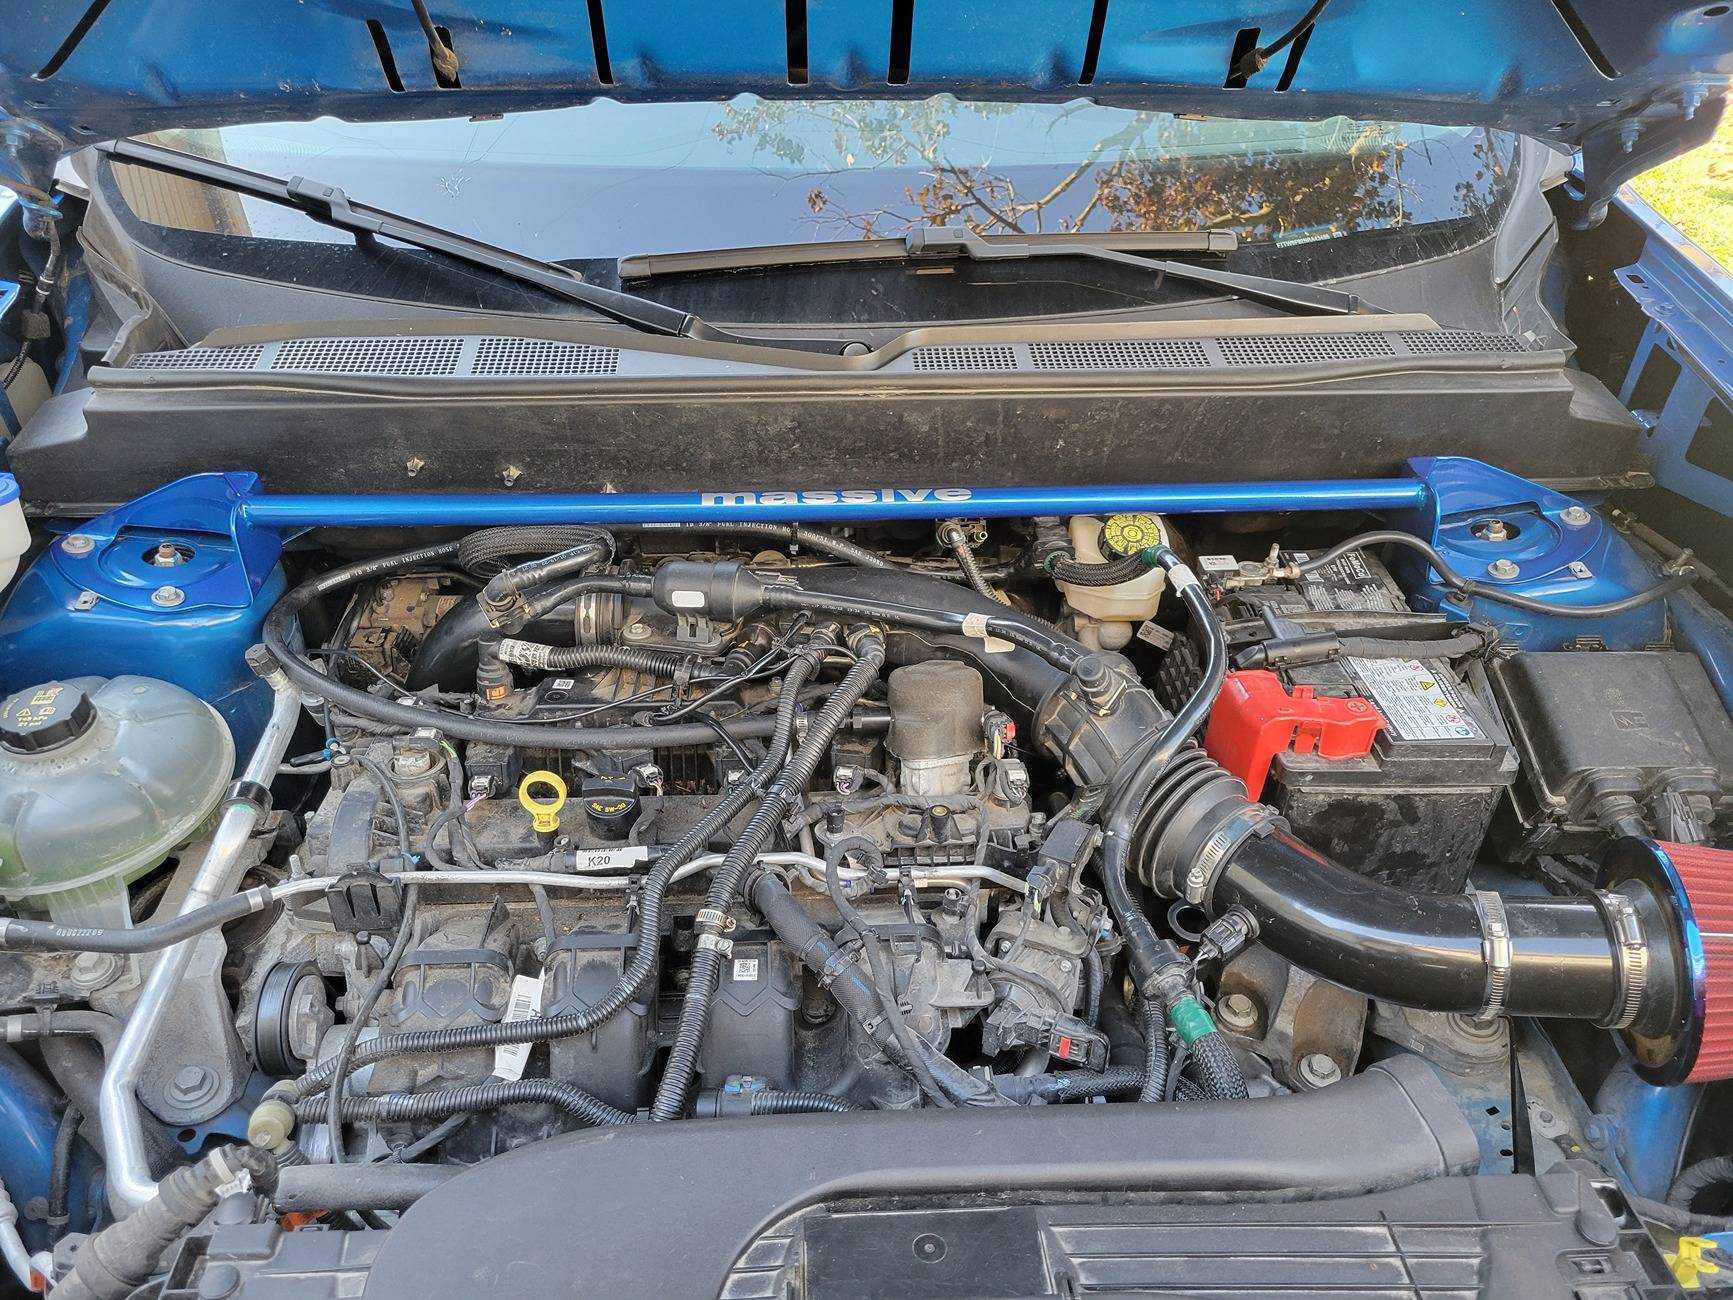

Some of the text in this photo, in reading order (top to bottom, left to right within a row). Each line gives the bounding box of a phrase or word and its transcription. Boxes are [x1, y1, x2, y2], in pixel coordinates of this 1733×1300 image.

[701, 487, 972, 505] massive
[740, 521, 778, 530] INJECTION
[382, 559, 399, 569] FUEL
[402, 550, 436, 564] INJECTION
[1346, 552, 1365, 578] FoMoCo
[591, 802, 626, 813] SAE 5W-30
[588, 855, 611, 867] K20
